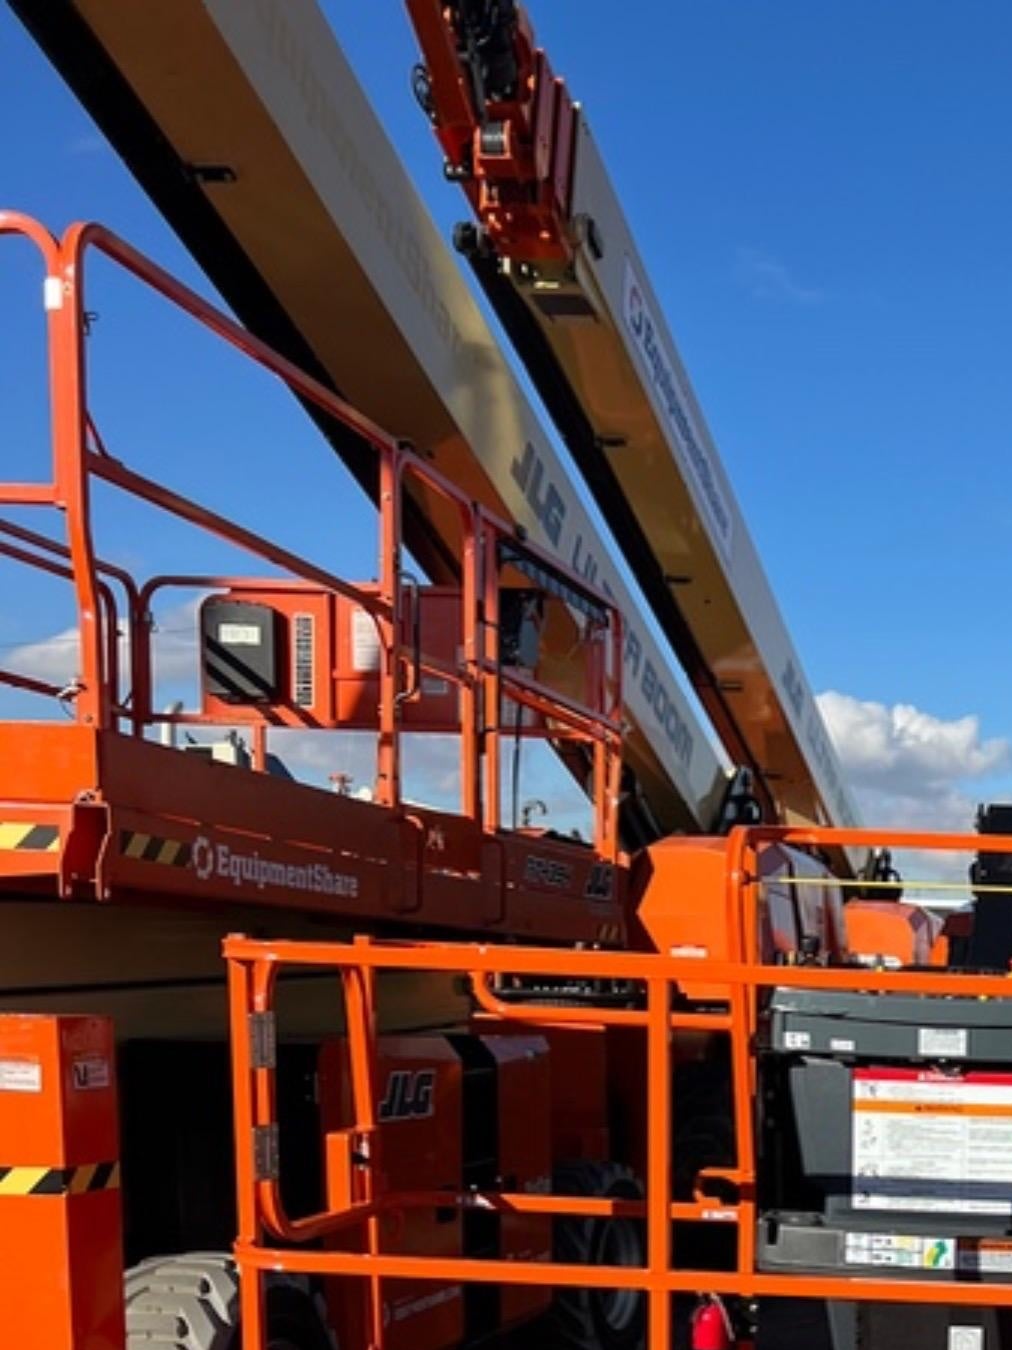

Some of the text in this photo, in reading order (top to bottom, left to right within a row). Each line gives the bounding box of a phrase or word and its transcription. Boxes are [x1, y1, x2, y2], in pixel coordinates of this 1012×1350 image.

[510, 440, 566, 549] JLG
[217, 845, 358, 898] EquipmentShare
[379, 1069, 437, 1121] JLG
